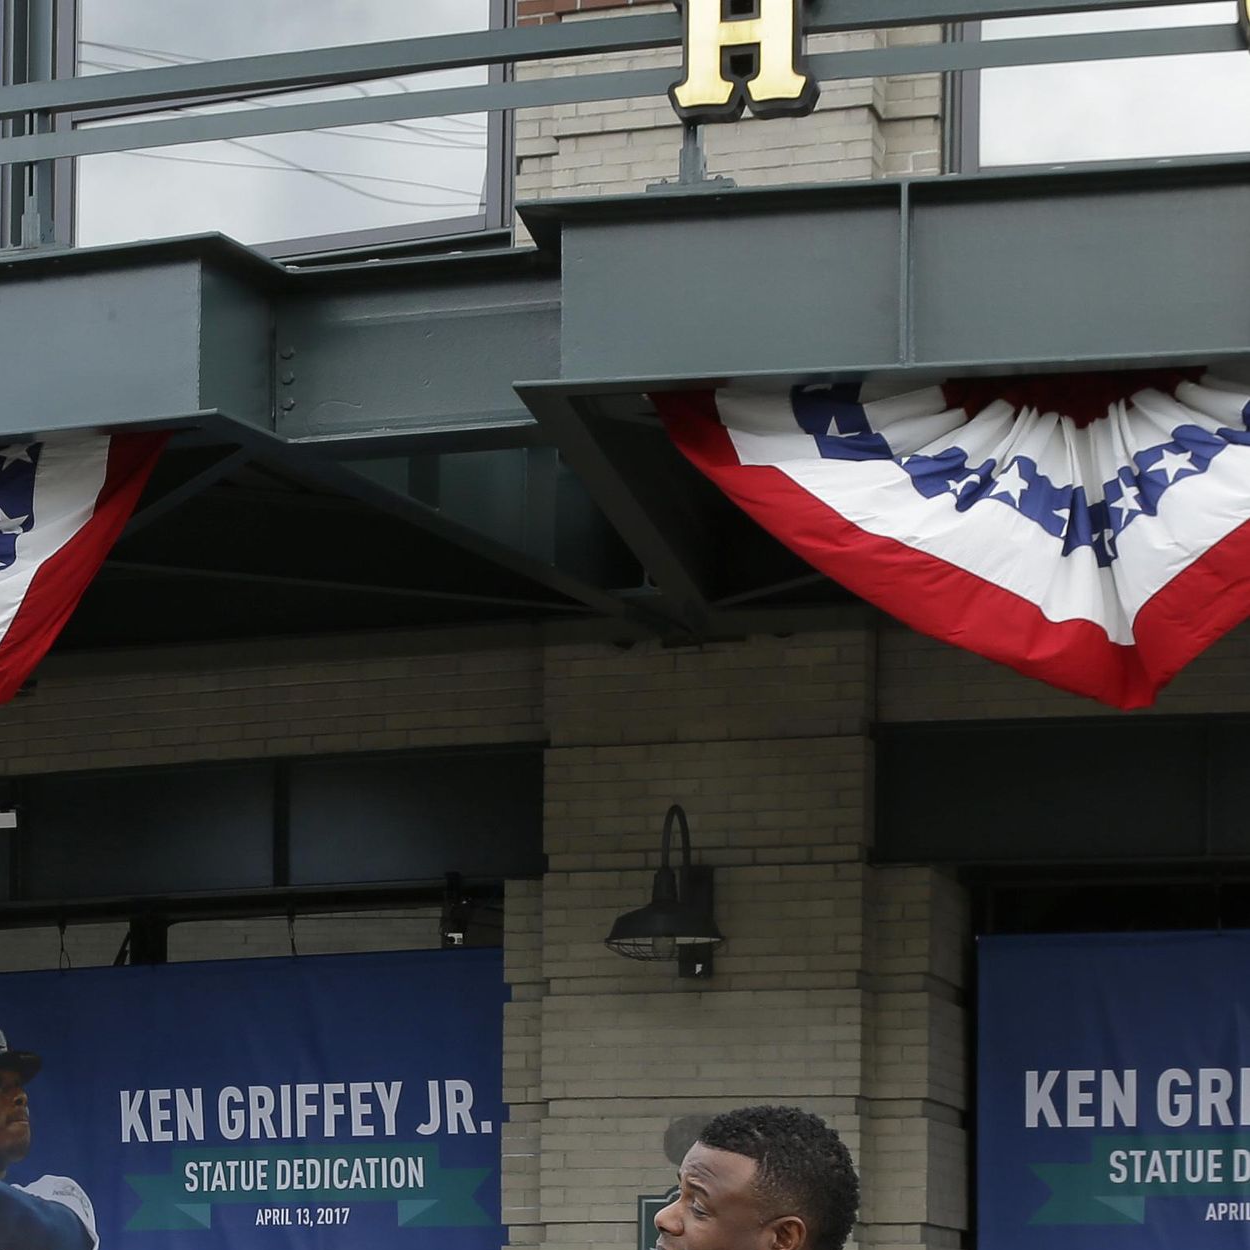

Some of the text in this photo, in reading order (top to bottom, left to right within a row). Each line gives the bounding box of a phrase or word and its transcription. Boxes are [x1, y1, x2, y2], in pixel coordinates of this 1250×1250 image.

[119, 1079, 493, 1143] KEN GRIFFEY JR.
[1025, 1069, 1137, 1128] KEN
[183, 1156, 425, 1192] STATUE DEDICATION
[1109, 1149, 1223, 1184] STATUE
[255, 1206, 350, 1228] APRIL 13, 2017
